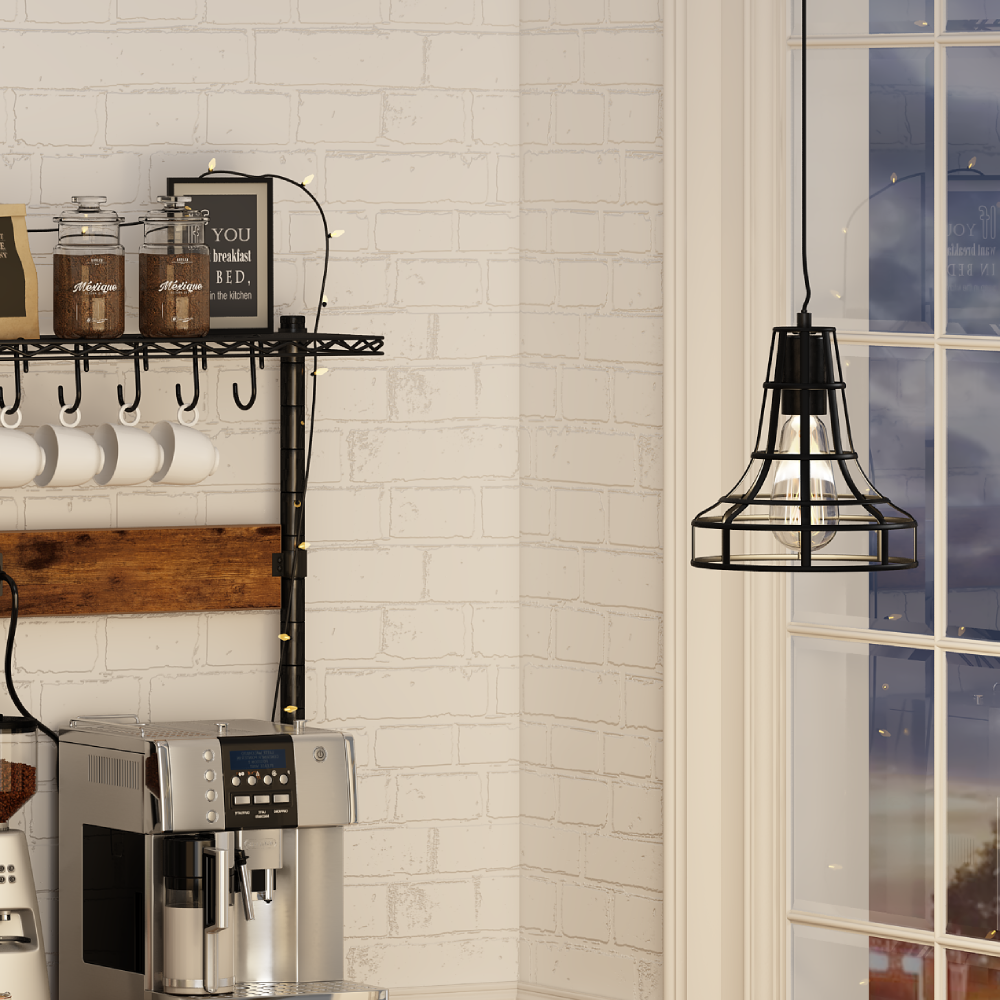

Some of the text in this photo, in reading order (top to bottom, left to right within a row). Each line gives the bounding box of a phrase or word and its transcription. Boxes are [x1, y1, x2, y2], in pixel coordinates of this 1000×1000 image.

[211, 228, 251, 242] YOU
[213, 248, 252, 262] breakfast
[216, 270, 251, 286] BED,
[72, 281, 118, 293] Méxique
[158, 280, 204, 292] Méxique
[217, 291, 228, 300] the
[230, 291, 252, 300] kitchen
